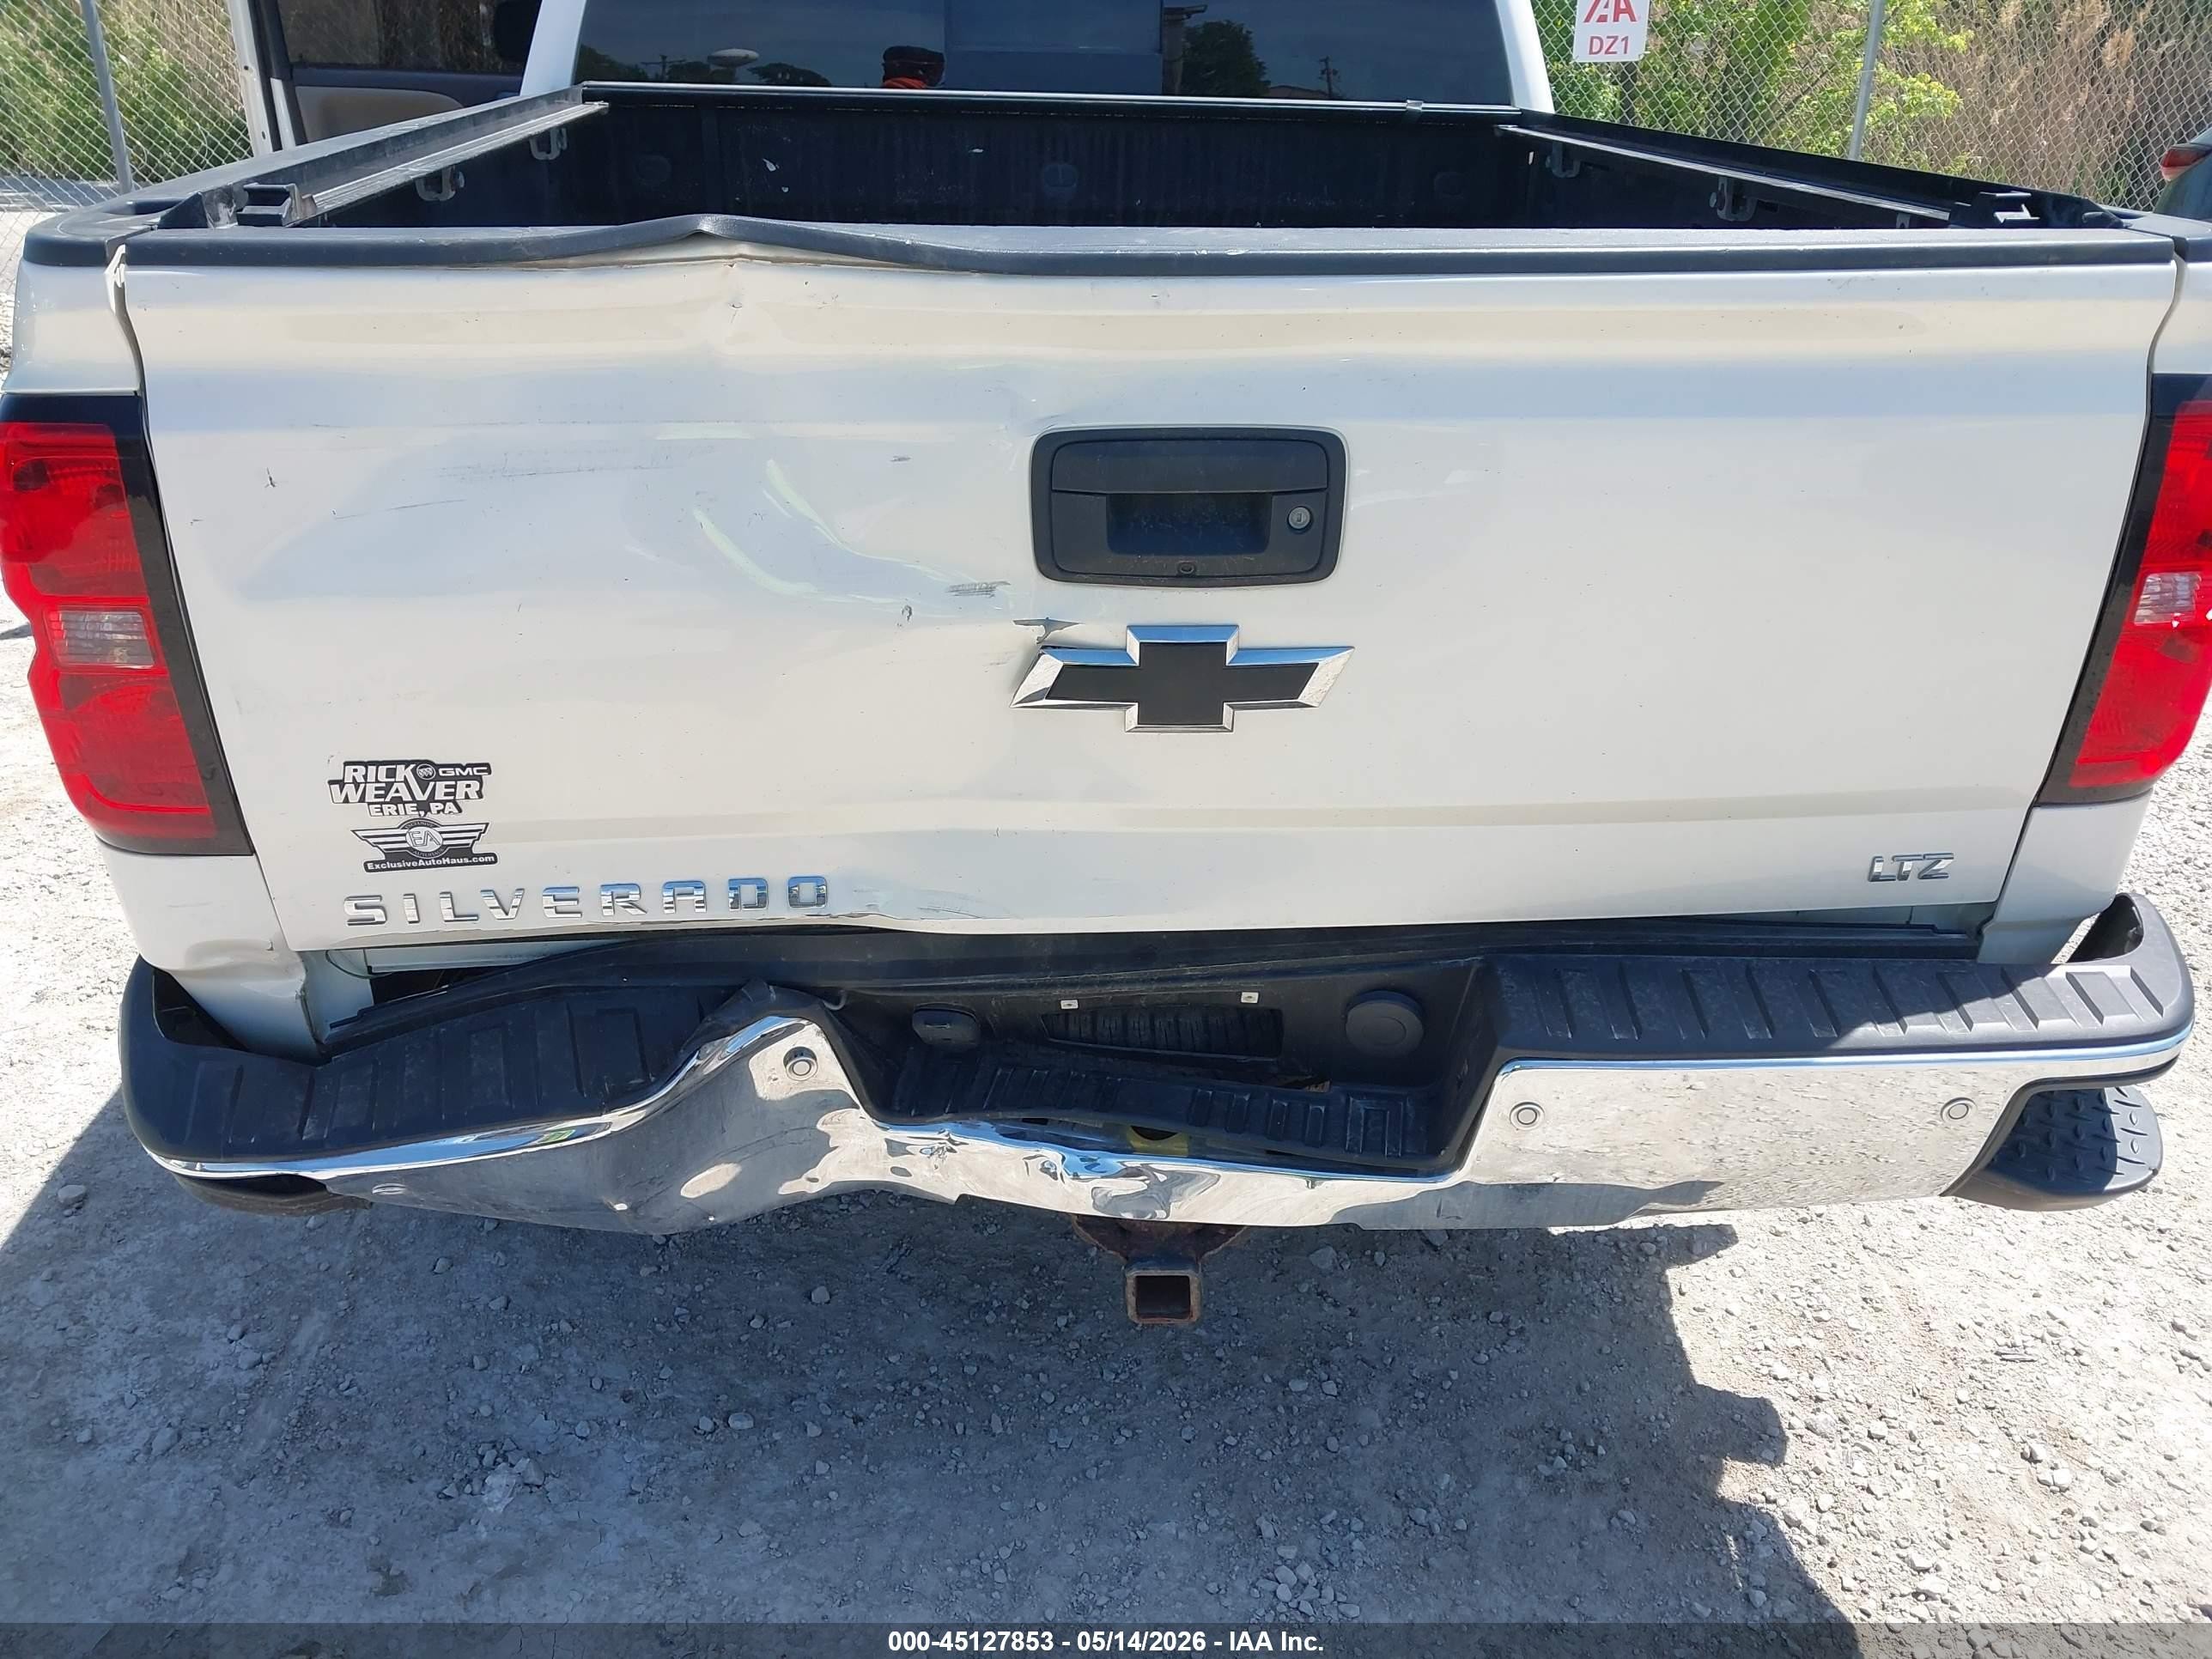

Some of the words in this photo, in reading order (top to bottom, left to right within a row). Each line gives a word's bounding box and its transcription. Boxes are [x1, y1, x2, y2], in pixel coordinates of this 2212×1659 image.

[1589, 35, 1629, 55] DZ1
[344, 763, 416, 783] RICK
[439, 766, 489, 776] GMC
[330, 780, 481, 804] WEAVER
[369, 803, 425, 817] ERIE,
[430, 801, 459, 814] PA
[368, 854, 495, 871] ExclusiveAutoHaus.com
[1868, 852, 1955, 882] LTZ
[343, 875, 828, 927] SILVERADO
